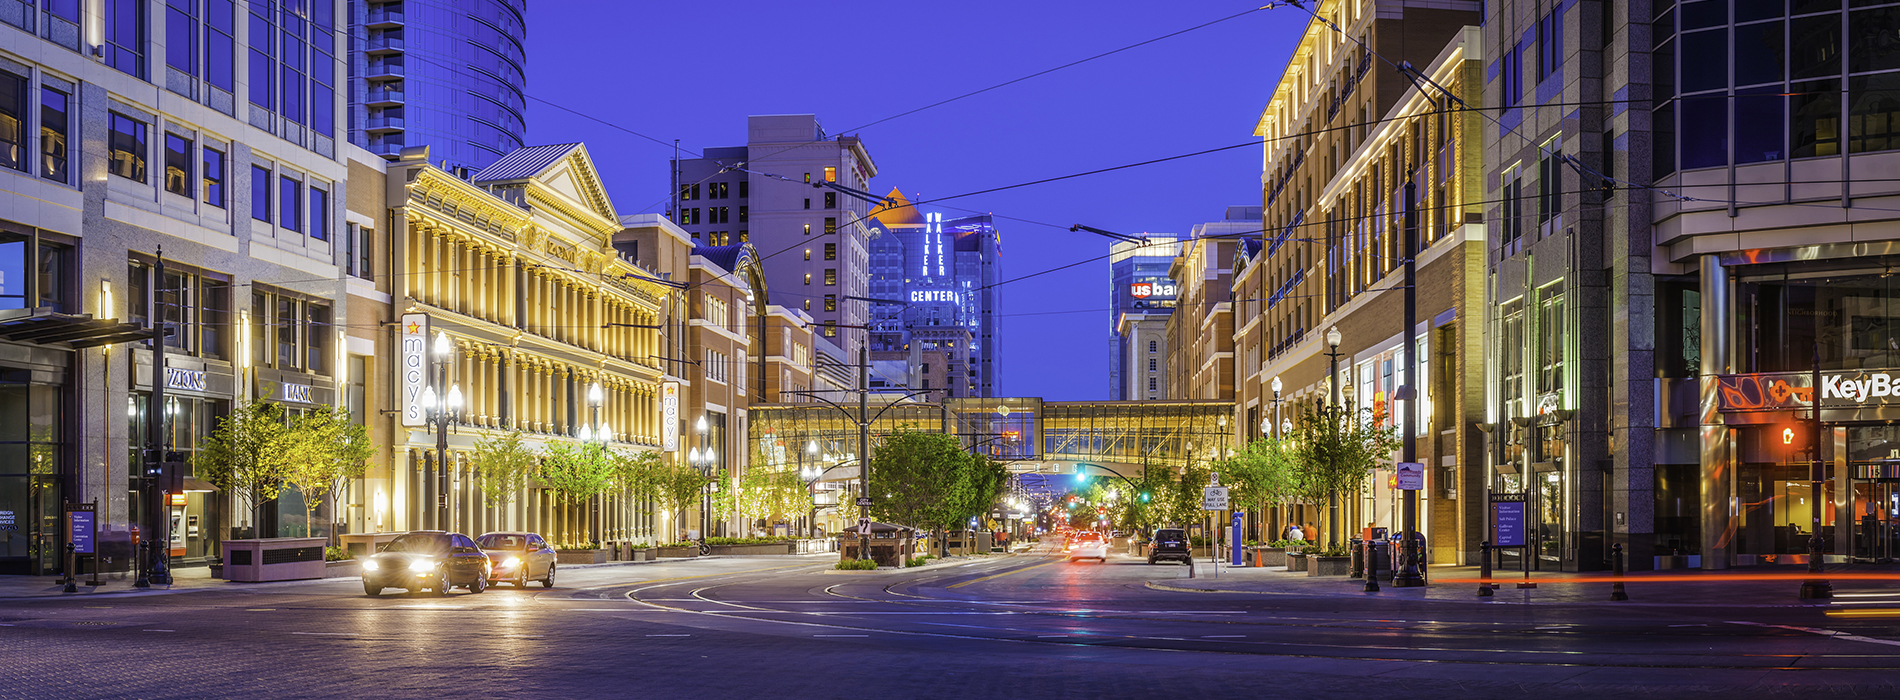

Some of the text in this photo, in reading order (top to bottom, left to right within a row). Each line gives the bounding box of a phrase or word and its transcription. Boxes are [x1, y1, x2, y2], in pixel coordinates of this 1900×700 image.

[547, 240, 575, 264] ZCMI
[922, 212, 933, 276] WALKER
[934, 211, 945, 276] WALKER
[911, 290, 954, 302] CENTER
[1131, 285, 1151, 296] us
[168, 368, 207, 391] ZIONS
[404, 338, 423, 419] macys
[283, 383, 313, 402] BANK
[664, 397, 677, 448] macys
